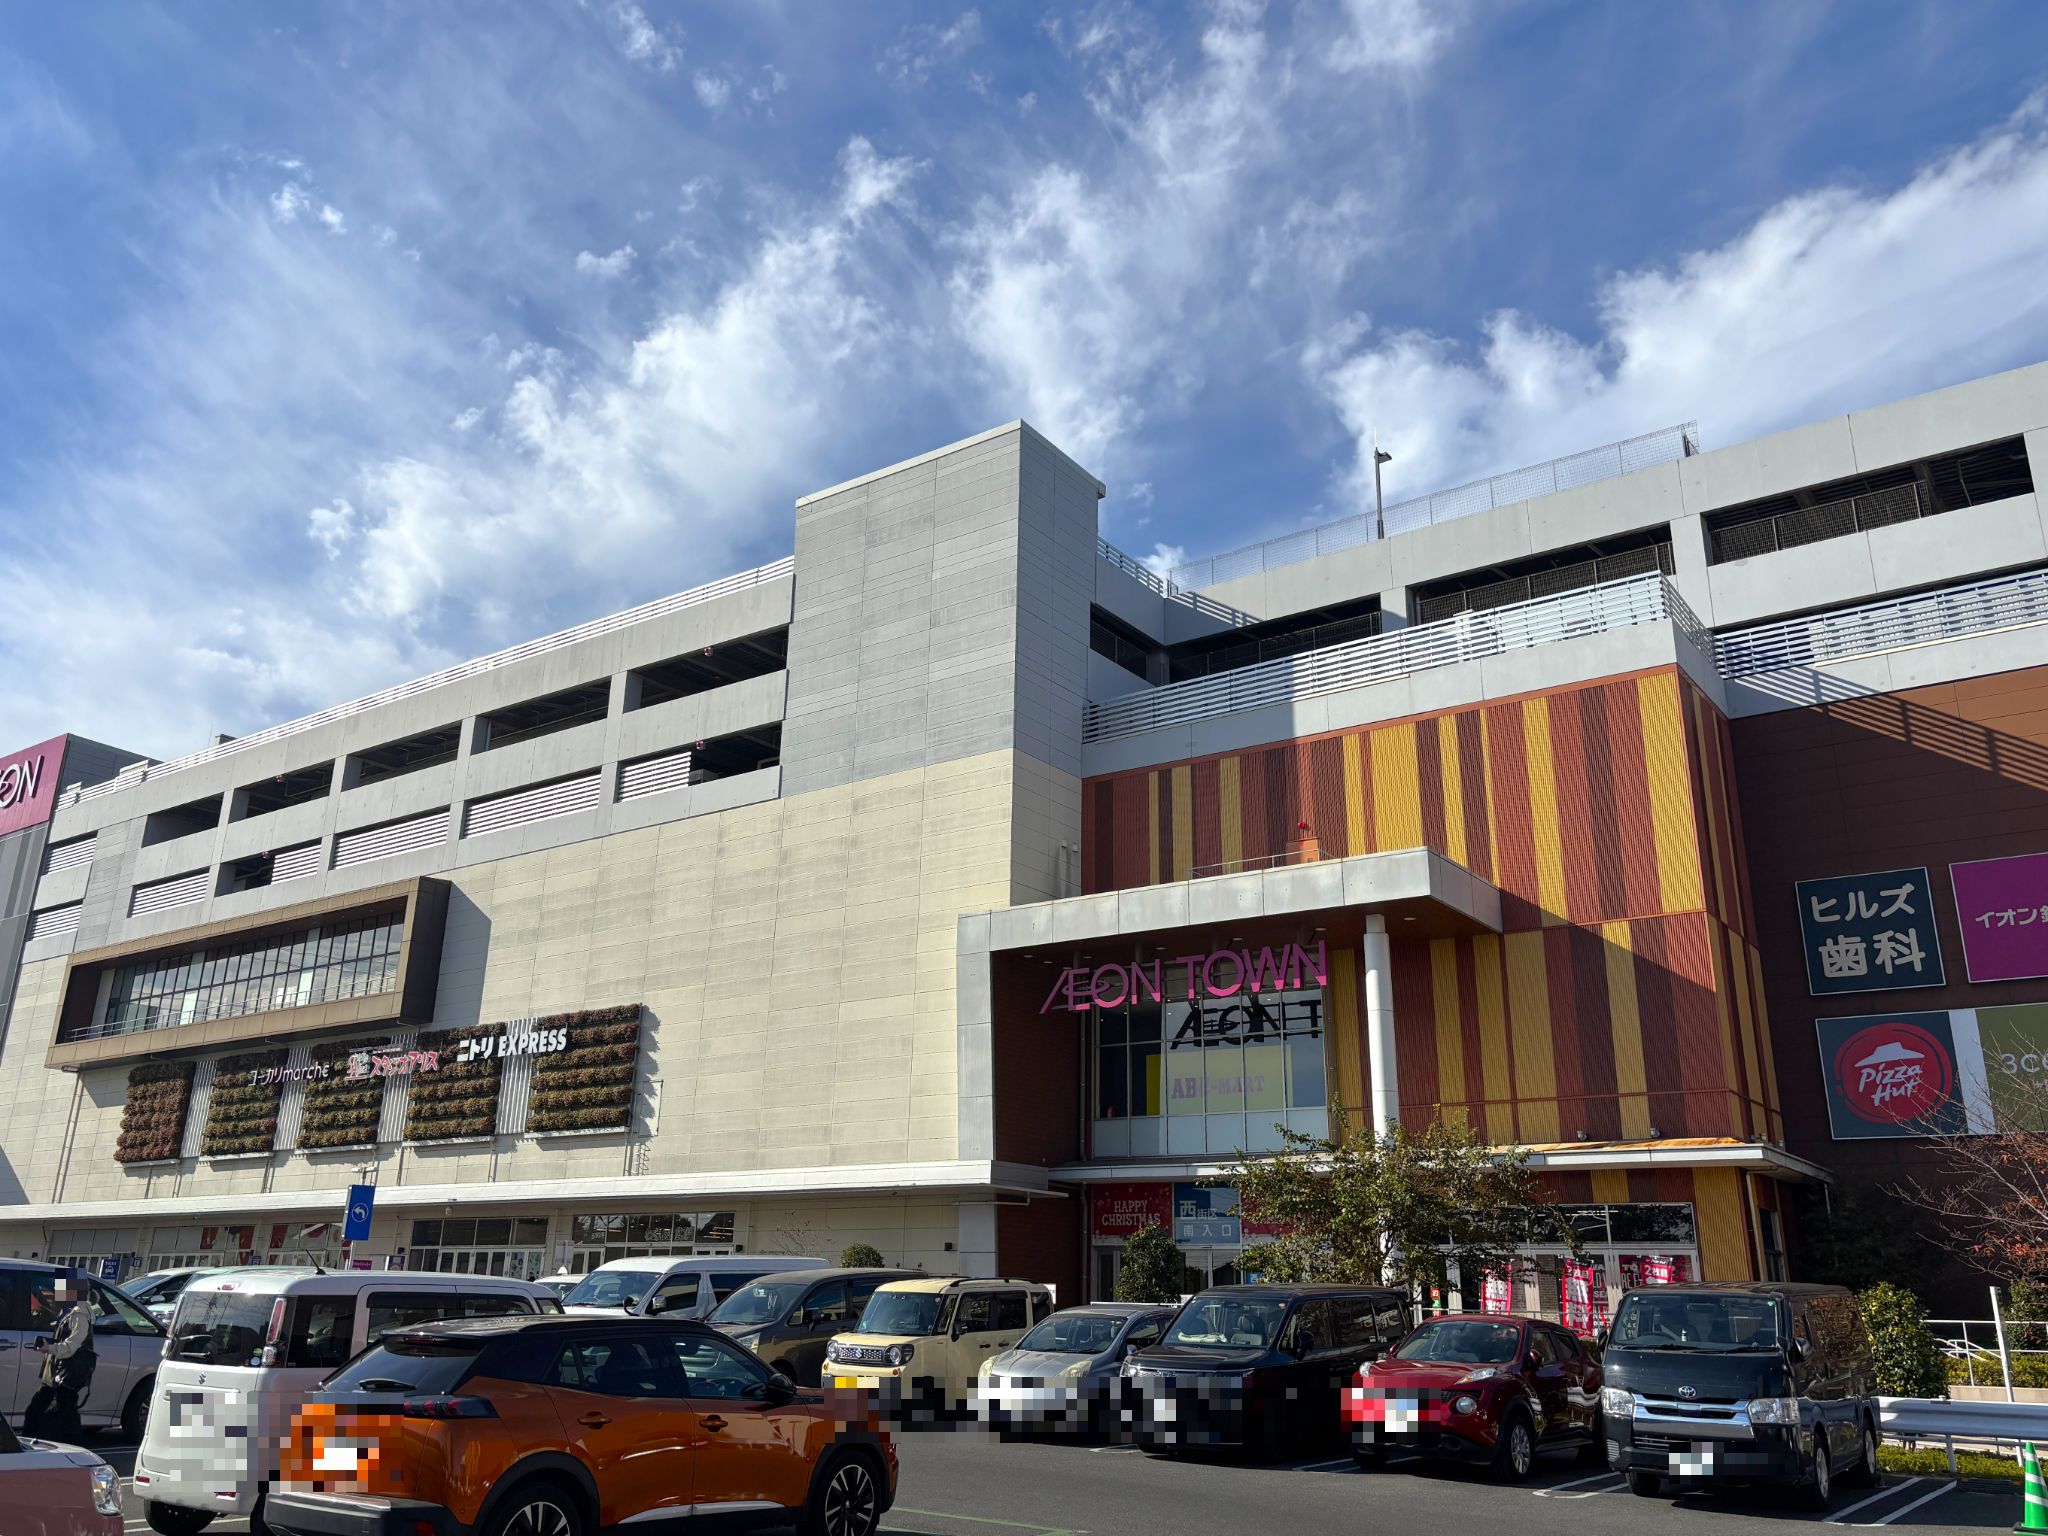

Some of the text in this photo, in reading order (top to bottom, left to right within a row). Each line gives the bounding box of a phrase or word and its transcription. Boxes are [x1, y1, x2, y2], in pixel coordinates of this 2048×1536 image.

[1811, 883, 1916, 922] ヒルズ
[1818, 928, 1926, 978] 歯科
[1176, 940, 1327, 1000] TOWN
[456, 1028, 567, 1062] ニトリ EXPRESS
[370, 1052, 439, 1078] スタジオアリス
[1858, 1062, 1923, 1093] Pizza
[1871, 1079, 1919, 1107] Hut
[1102, 1212, 1161, 1227] CHRISTMAS
[1113, 1200, 1148, 1213] HAPPY
[1179, 1200, 1218, 1220] 西街区
[1183, 1224, 1232, 1237] 南入口
[1644, 1263, 1668, 1278] 2枚目
